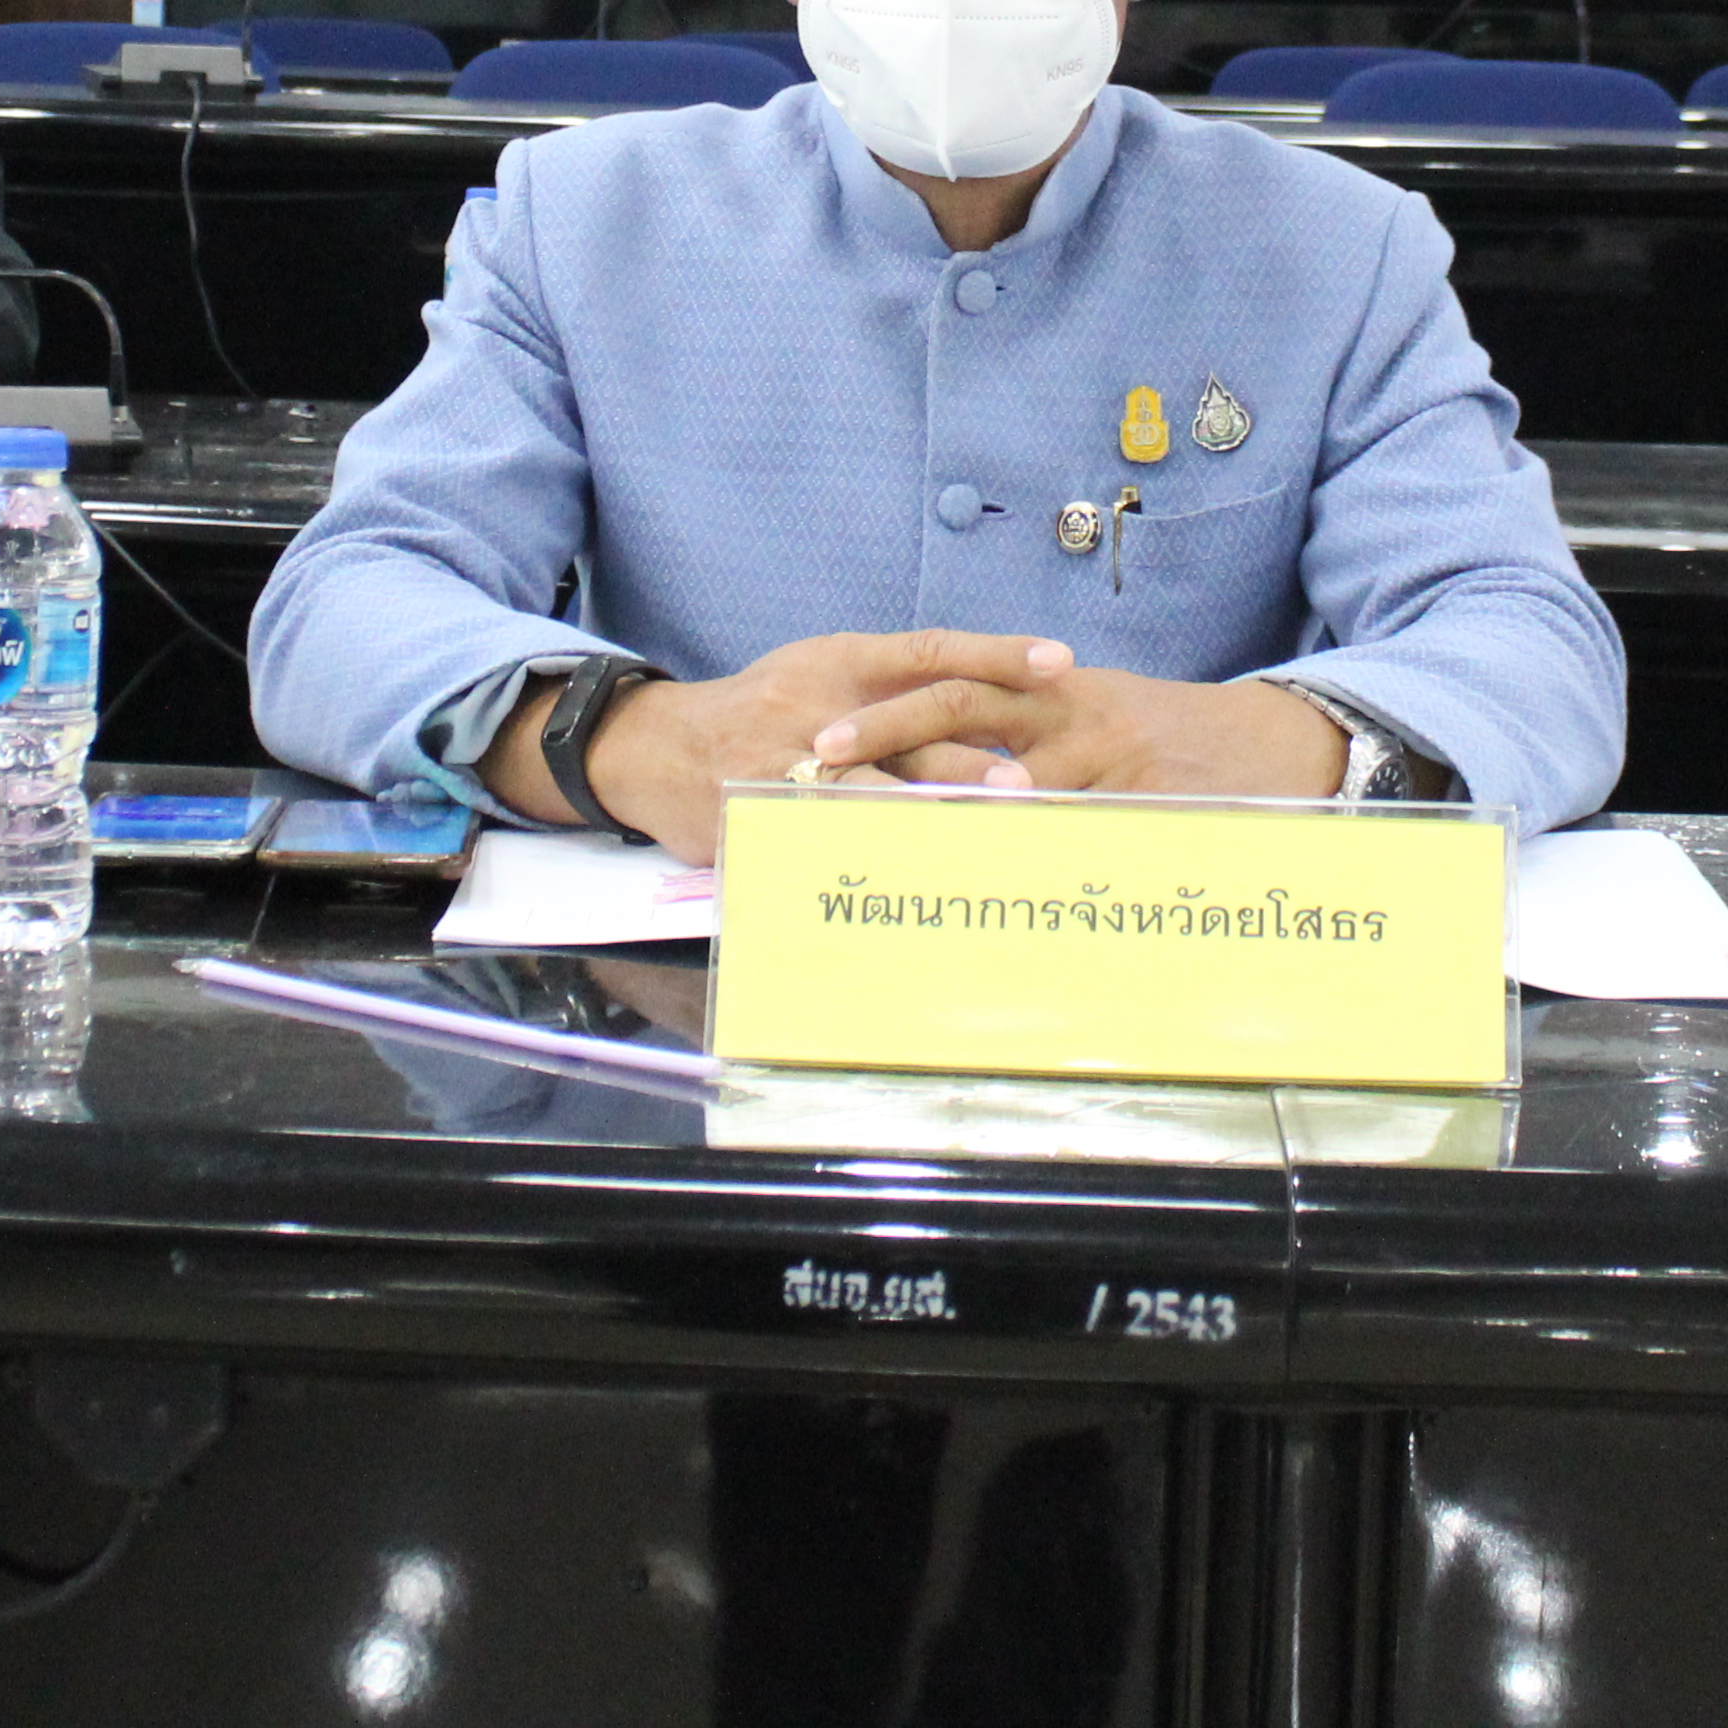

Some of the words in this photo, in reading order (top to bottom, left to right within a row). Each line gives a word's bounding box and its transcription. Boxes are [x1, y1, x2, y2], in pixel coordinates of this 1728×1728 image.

[817, 874, 1389, 944] พัฒนาการจังหวัดยโสธร
[1125, 1290, 1237, 1341] 2543
